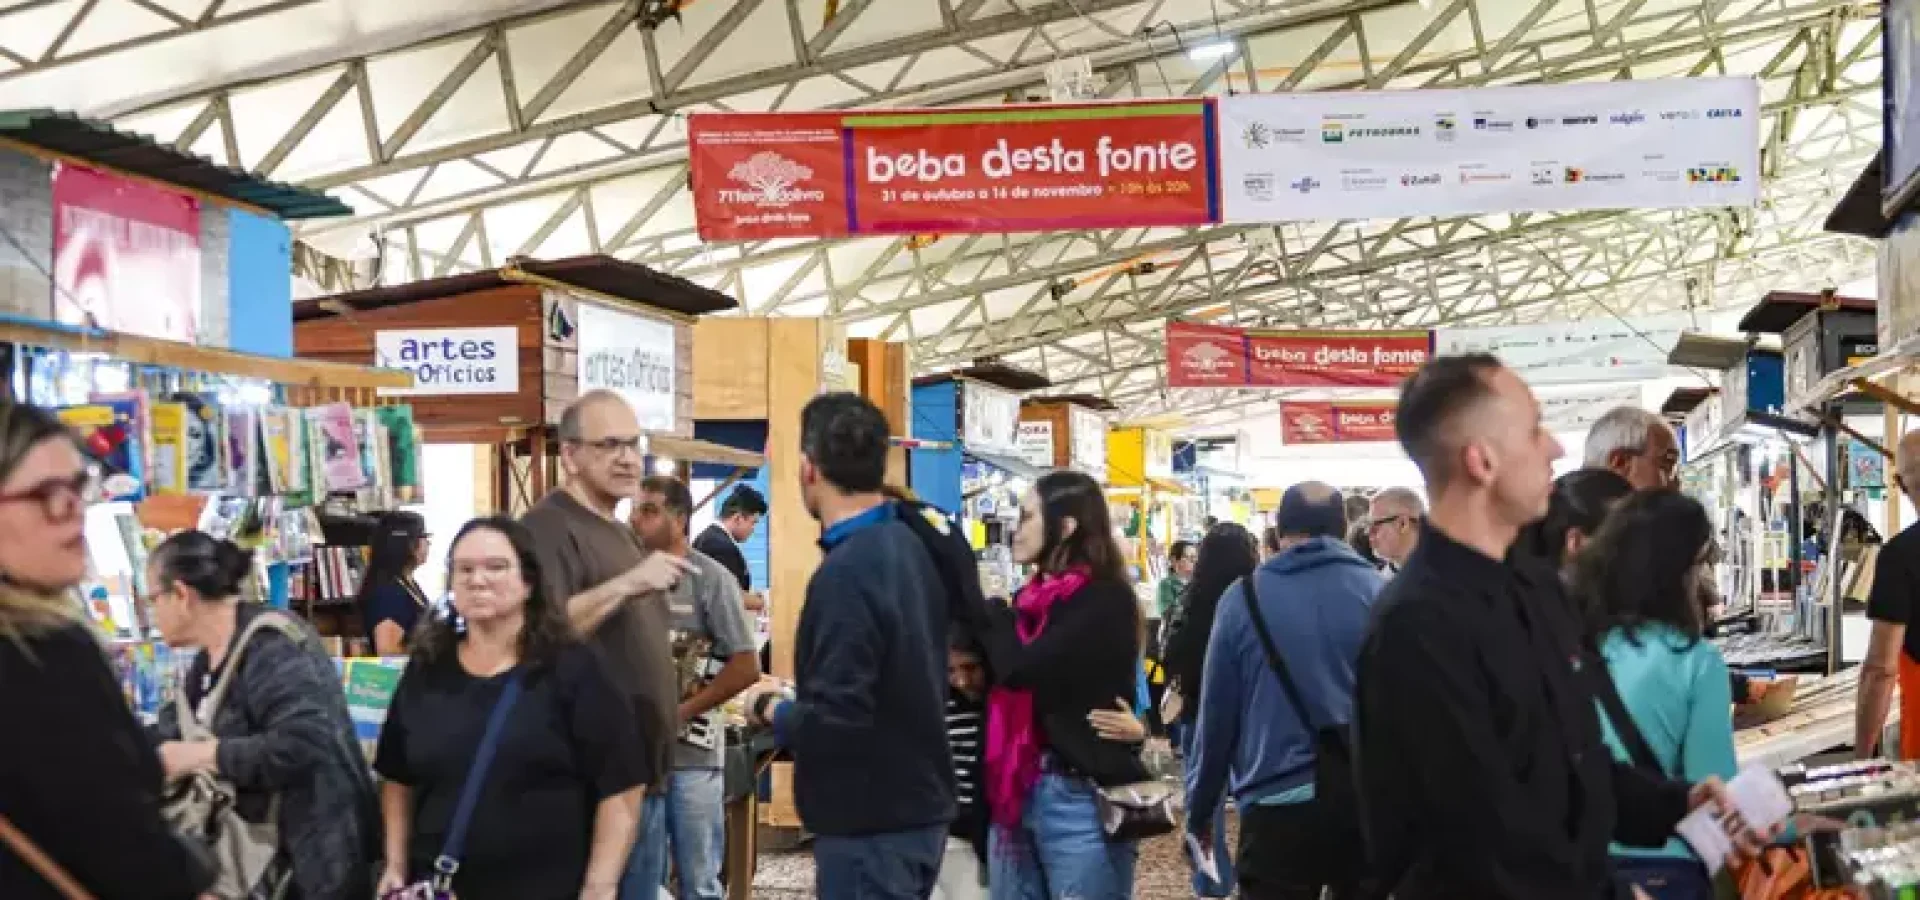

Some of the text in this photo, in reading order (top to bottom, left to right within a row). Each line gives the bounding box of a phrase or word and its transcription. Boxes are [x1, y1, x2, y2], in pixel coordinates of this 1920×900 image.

[866, 135, 1197, 182] beba desta fonte
[882, 189, 897, 201] 31
[901, 188, 919, 201] de
[922, 187, 975, 201] outubro
[979, 190, 988, 199] a
[1011, 186, 1030, 199] de
[1032, 182, 1103, 198] novembro
[399, 337, 496, 360] artes
[1255, 344, 1425, 366] beba desta fonte
